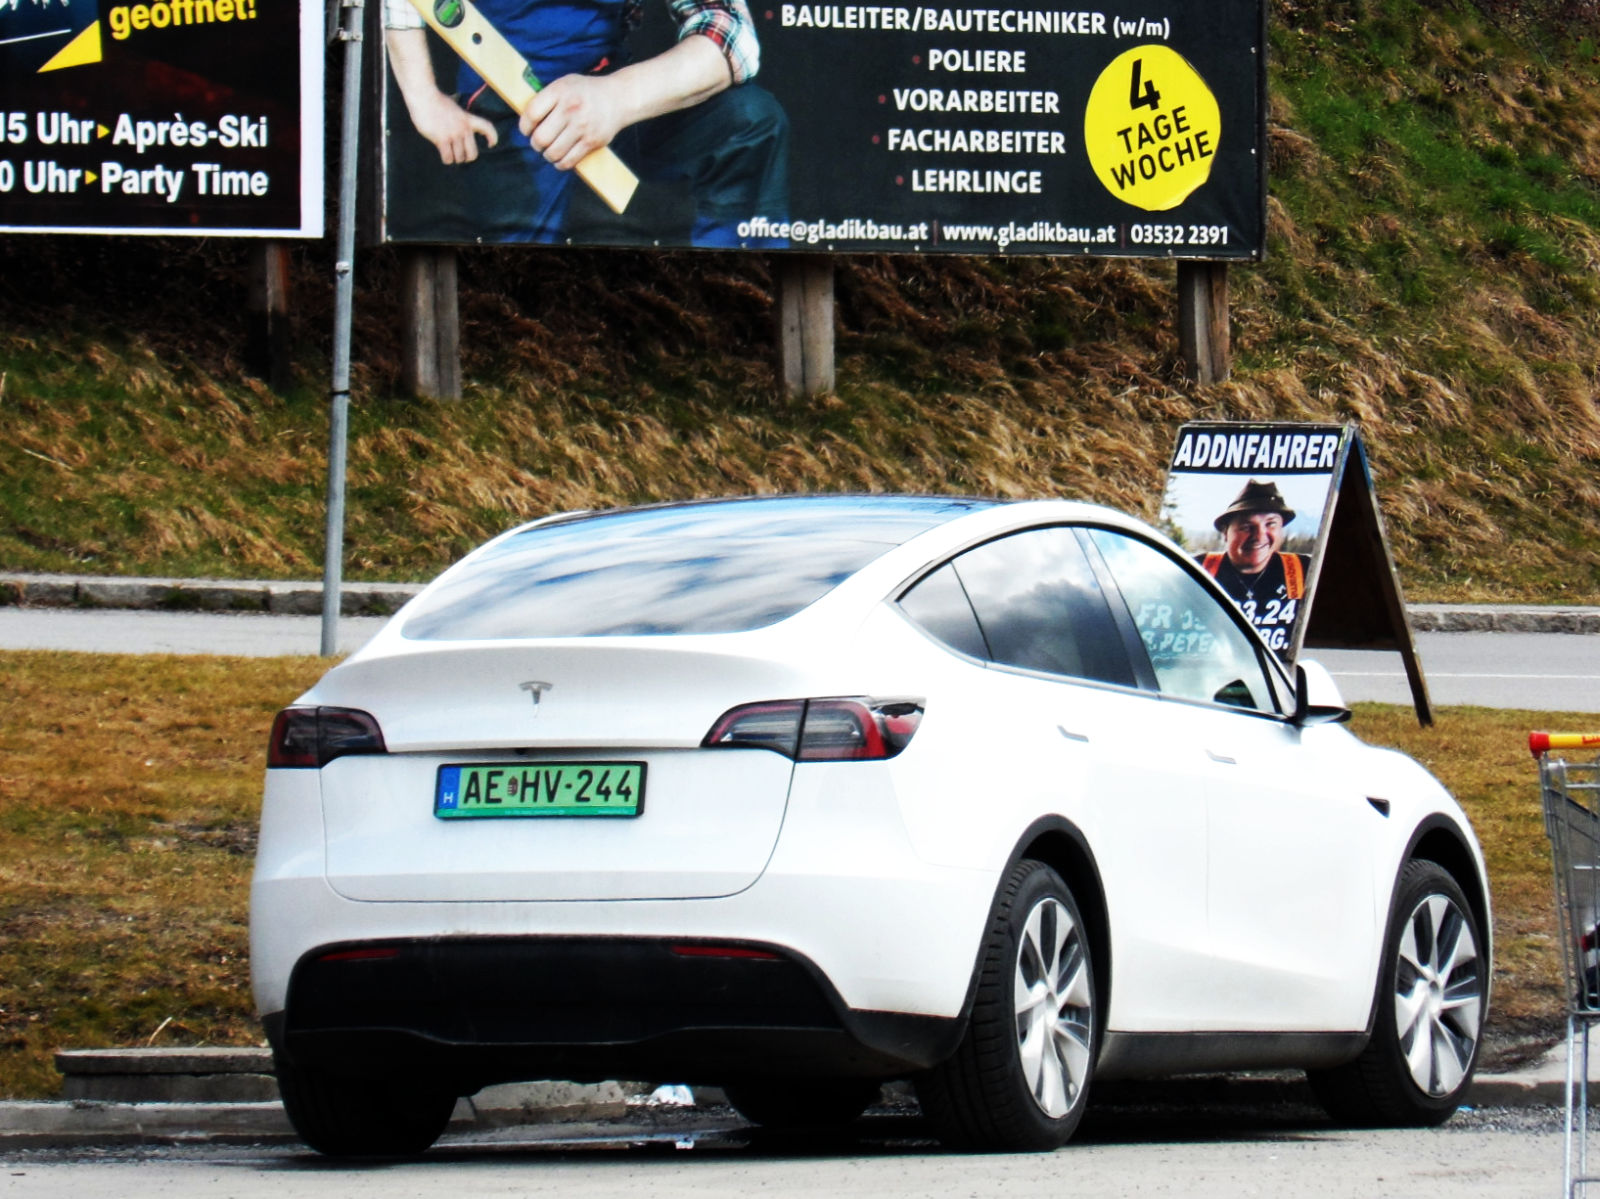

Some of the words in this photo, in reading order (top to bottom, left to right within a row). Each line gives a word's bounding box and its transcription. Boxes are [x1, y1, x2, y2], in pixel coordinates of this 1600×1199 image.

[109, 0, 256, 40] geöffnet!
[781, 5, 1107, 35] BAULEITER/BAUTECHNIKER
[1113, 16, 1170, 40] (w/m)
[928, 48, 1026, 73] POLIERE
[893, 88, 1060, 114] VORARBEITER
[1130, 58, 1161, 110] 4
[37, 112, 95, 144] Uhr
[112, 112, 268, 153] Après-Ski
[888, 129, 1066, 154] FACHARBEITER
[1117, 106, 1190, 153] TAGE
[1110, 130, 1213, 190] WOCHE
[24, 161, 82, 193] Uhr
[101, 162, 184, 203] Party
[191, 164, 269, 195] Time
[912, 169, 1042, 194] LEHRLINGE
[737, 216, 929, 244] office@gladikbau.at
[943, 222, 1116, 246] www.gladikbau.at
[1131, 225, 1184, 244] 03532
[1189, 225, 1228, 244] 2391
[1173, 434, 1338, 469] ADDNFAHRER
[464, 771, 504, 803] AE
[519, 770, 632, 803] HV-244
